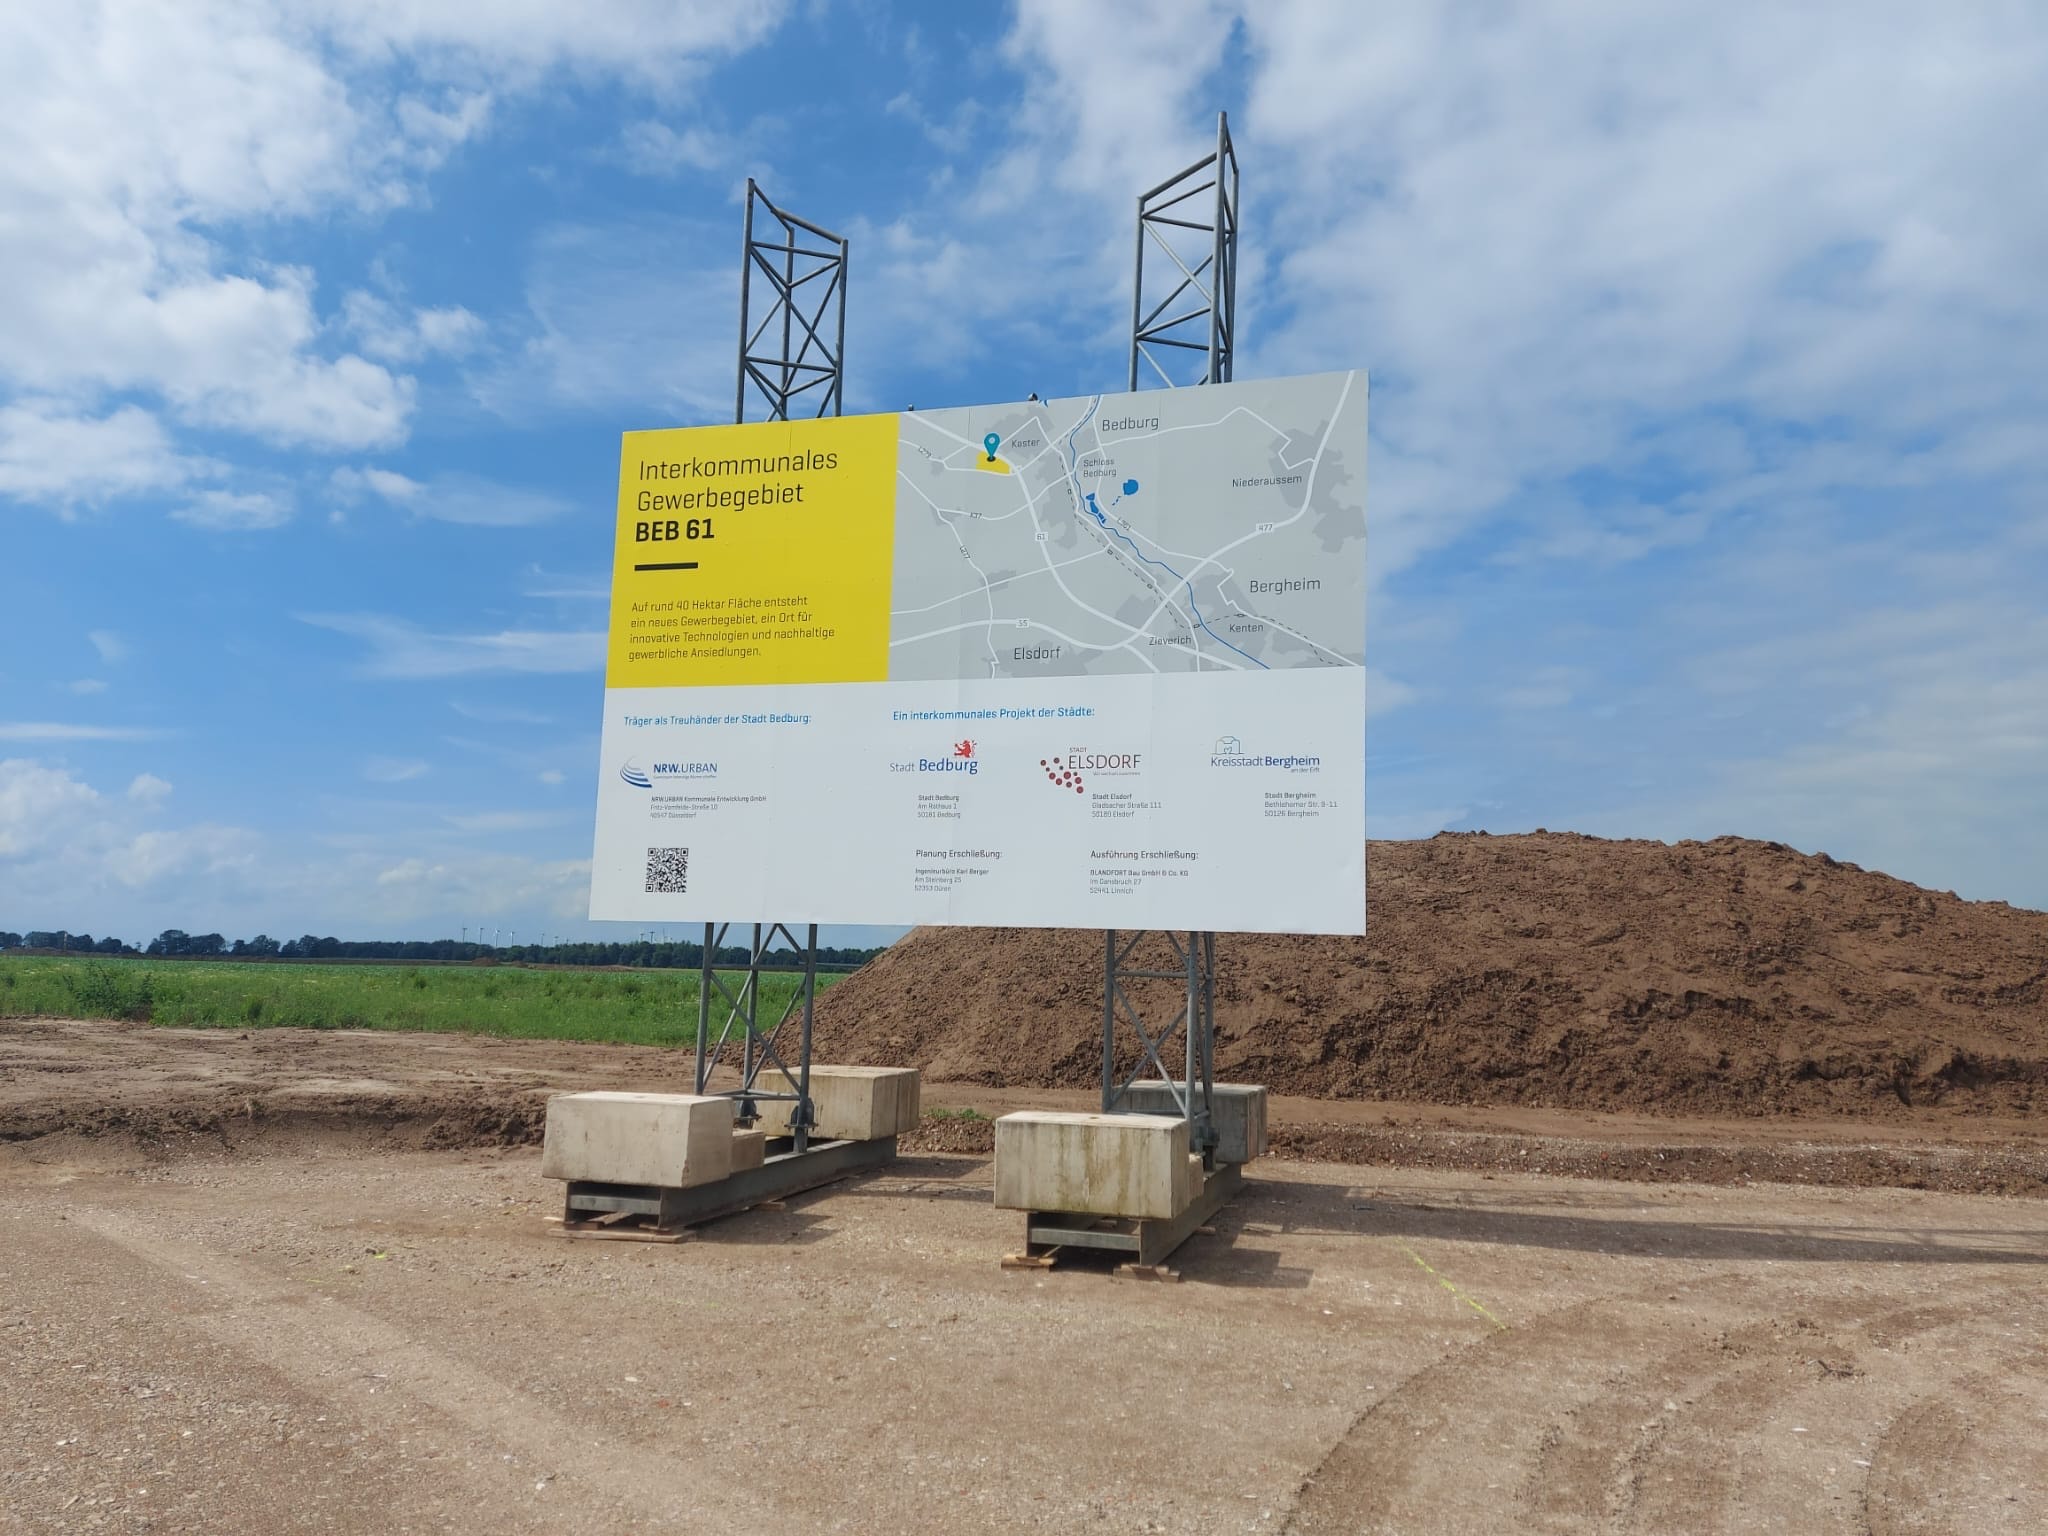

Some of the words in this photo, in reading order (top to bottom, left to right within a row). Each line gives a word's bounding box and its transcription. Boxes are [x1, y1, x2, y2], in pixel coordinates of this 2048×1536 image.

[1102, 417, 1158, 431] Bedburg
[639, 450, 838, 480] Interkommunales
[1083, 458, 1114, 467] Schloss
[1083, 468, 1117, 478] Bedburg
[1233, 475, 1302, 487] Niederaussem
[638, 483, 804, 511] Gewerbegebiet
[636, 521, 679, 542] BEB
[686, 518, 715, 539] 61
[1250, 578, 1321, 594] Bergheim
[632, 602, 648, 612] Auf
[651, 600, 673, 611] rund
[677, 600, 689, 610] 40
[692, 599, 725, 610] Hektar
[728, 597, 761, 609] Fläche
[764, 596, 808, 608] entsteht
[631, 618, 645, 628] ein
[648, 618, 678, 627] neues
[681, 614, 758, 627] Gewerbegebiet,
[761, 614, 775, 623] ein
[779, 613, 794, 622] Ort
[797, 612, 812, 622] für
[1229, 623, 1263, 632] Kenten
[630, 632, 680, 643] innovative
[683, 631, 749, 644] Technologien
[752, 630, 771, 640] und
[774, 627, 835, 640] nachhaltige
[1149, 636, 1192, 645] Zieverich
[629, 647, 688, 662] gewerbliche
[691, 646, 761, 659] Ansiedlungen.
[1014, 647, 1060, 660] Elsdorf
[624, 716, 652, 727] Träger
[655, 716, 668, 725] als
[671, 715, 721, 724] Treuhänder
[724, 714, 739, 724] der
[742, 714, 766, 723] Stadt
[769, 713, 811, 724] Bedburg:
[893, 711, 908, 720] Ein
[911, 709, 997, 720] interkommunales
[1000, 708, 1035, 720] Projekt
[1038, 708, 1054, 718] der
[1058, 707, 1095, 717] Städte:
[654, 763, 717, 773] NRW.URBAN
[890, 762, 915, 772] Stadt
[919, 759, 978, 774] Bedburg
[1069, 755, 1141, 769] ELSDORF
[1211, 756, 1263, 767] Kreisstadt
[1265, 756, 1320, 768] Bergheim
[1288, 810, 1319, 818] Bergheim
[916, 850, 947, 858] Planung
[949, 850, 1002, 859] Erschließung:
[1091, 850, 1138, 860] Ausführung
[1141, 850, 1199, 860] Erschließung:
